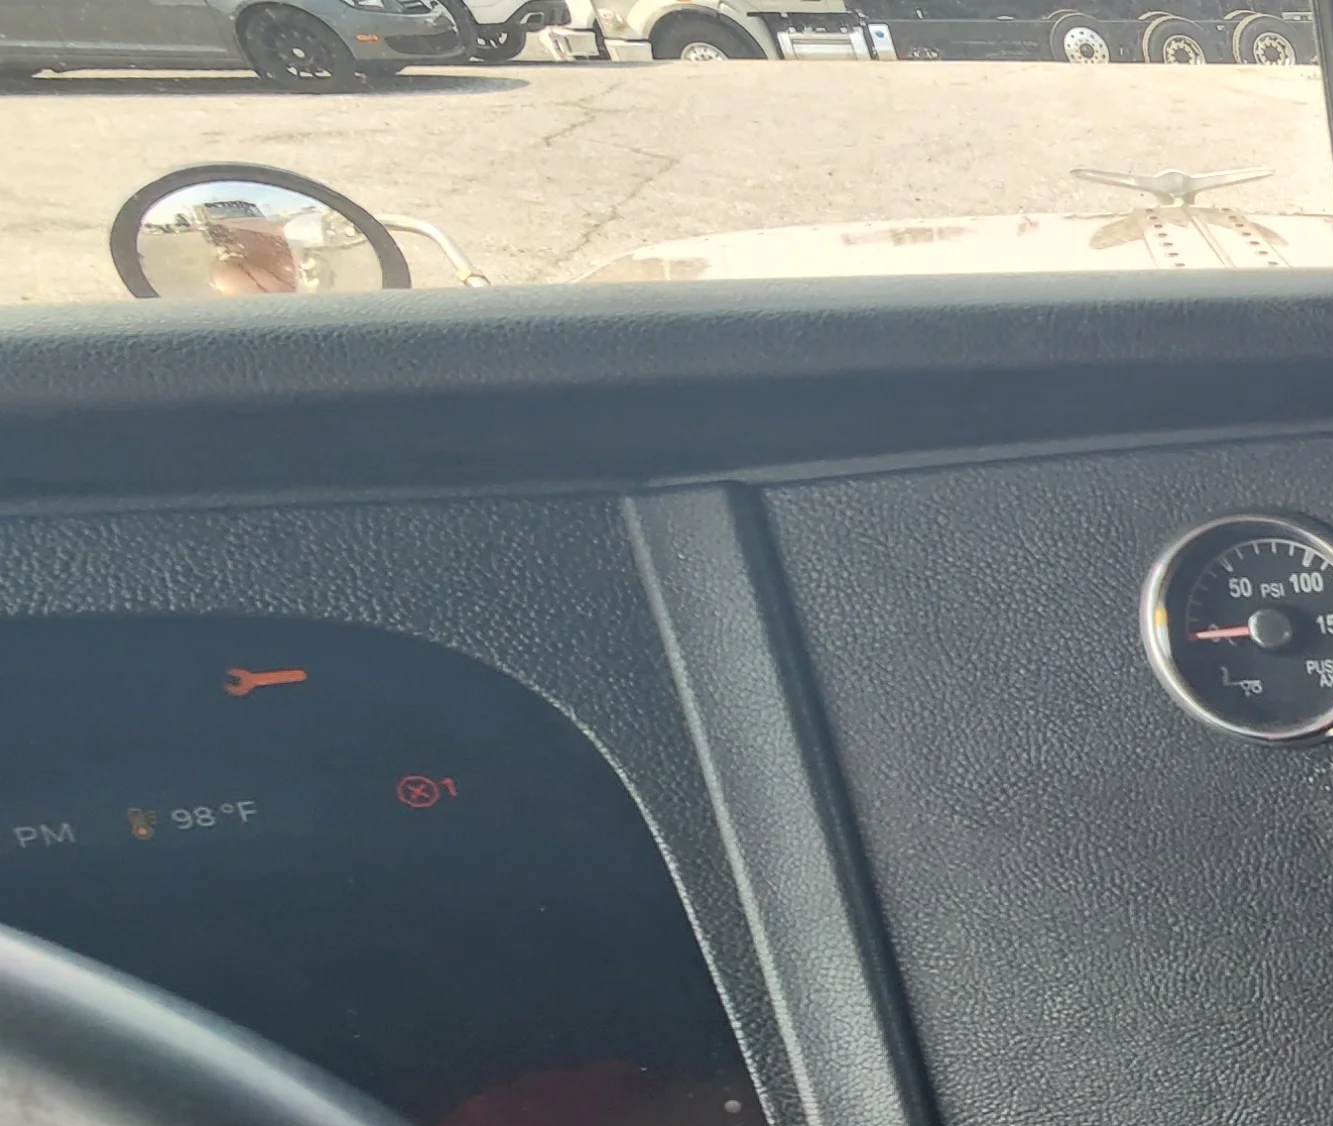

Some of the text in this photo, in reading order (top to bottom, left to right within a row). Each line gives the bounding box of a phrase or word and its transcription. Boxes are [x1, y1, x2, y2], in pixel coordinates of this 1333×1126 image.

[1229, 573, 1323, 598] 50 PSI 100
[13, 822, 77, 848] PM
